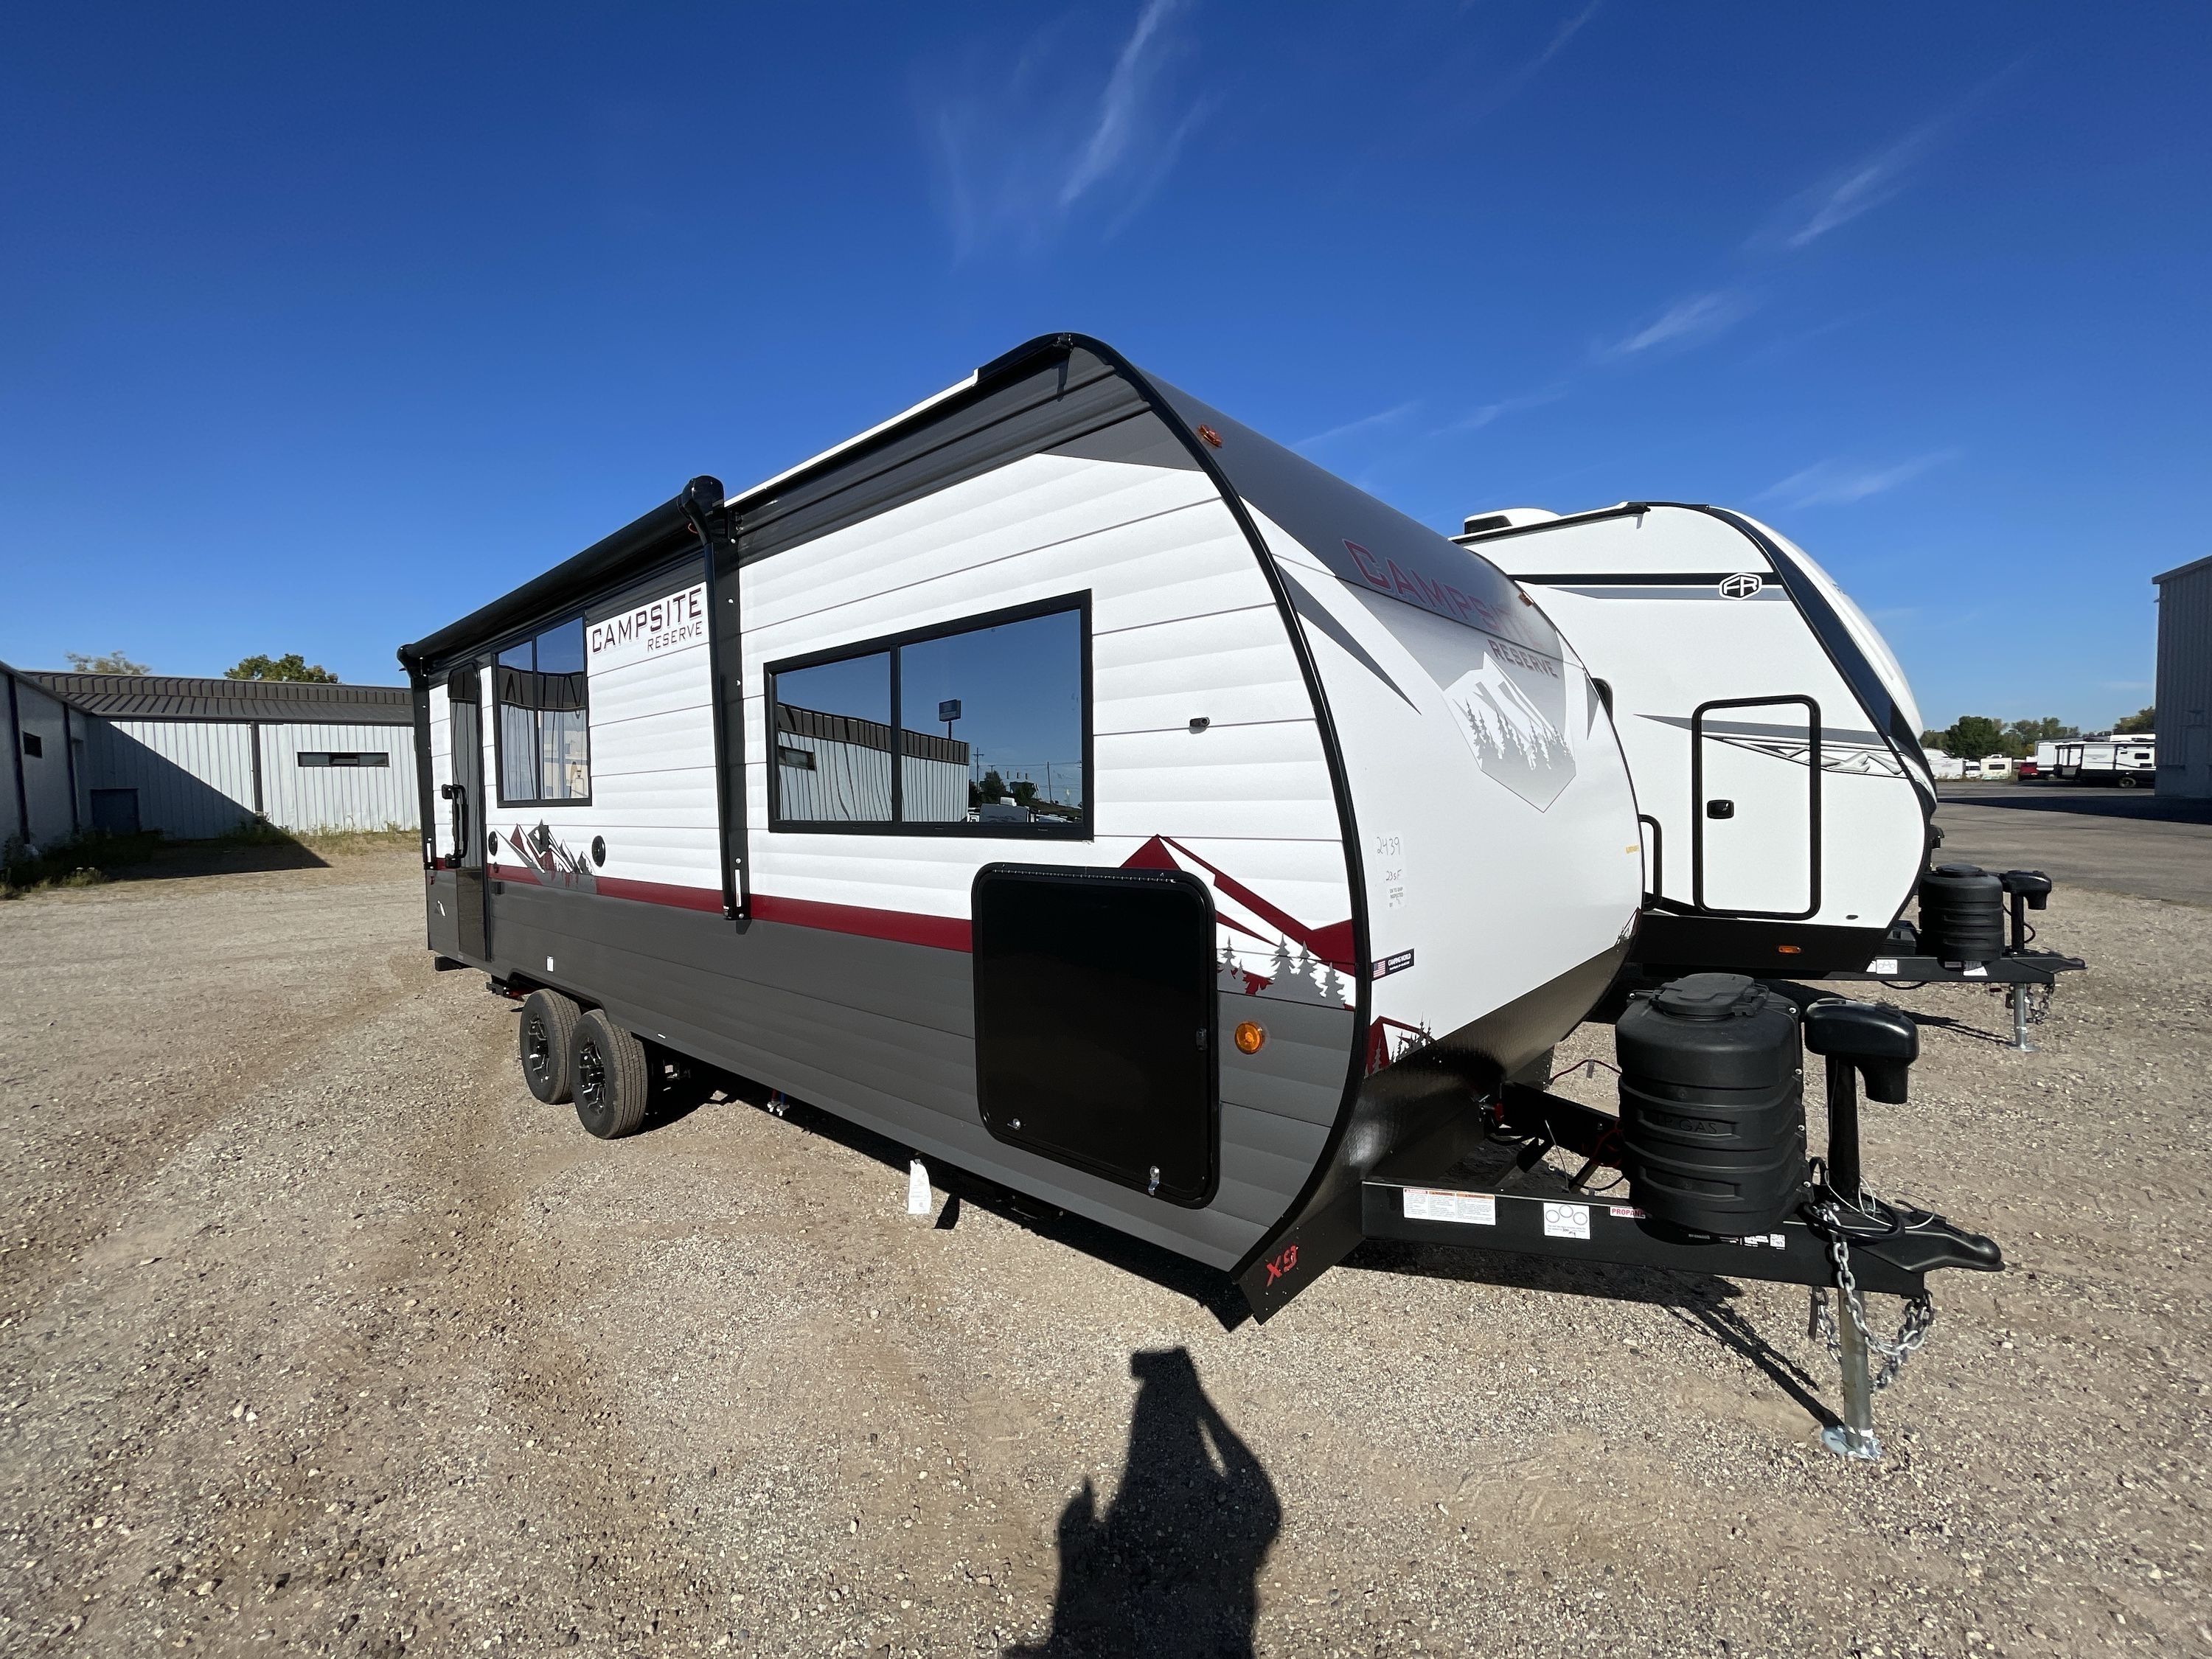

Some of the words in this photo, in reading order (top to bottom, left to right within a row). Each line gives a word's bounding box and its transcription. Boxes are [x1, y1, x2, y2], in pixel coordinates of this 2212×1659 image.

[592, 588, 702, 653] CAMPSITE
[647, 621, 703, 651] RESERVE
[1487, 639, 1559, 679] RESERVE
[1376, 836, 1401, 855] 2439
[1680, 1119, 1717, 1134] GAS
